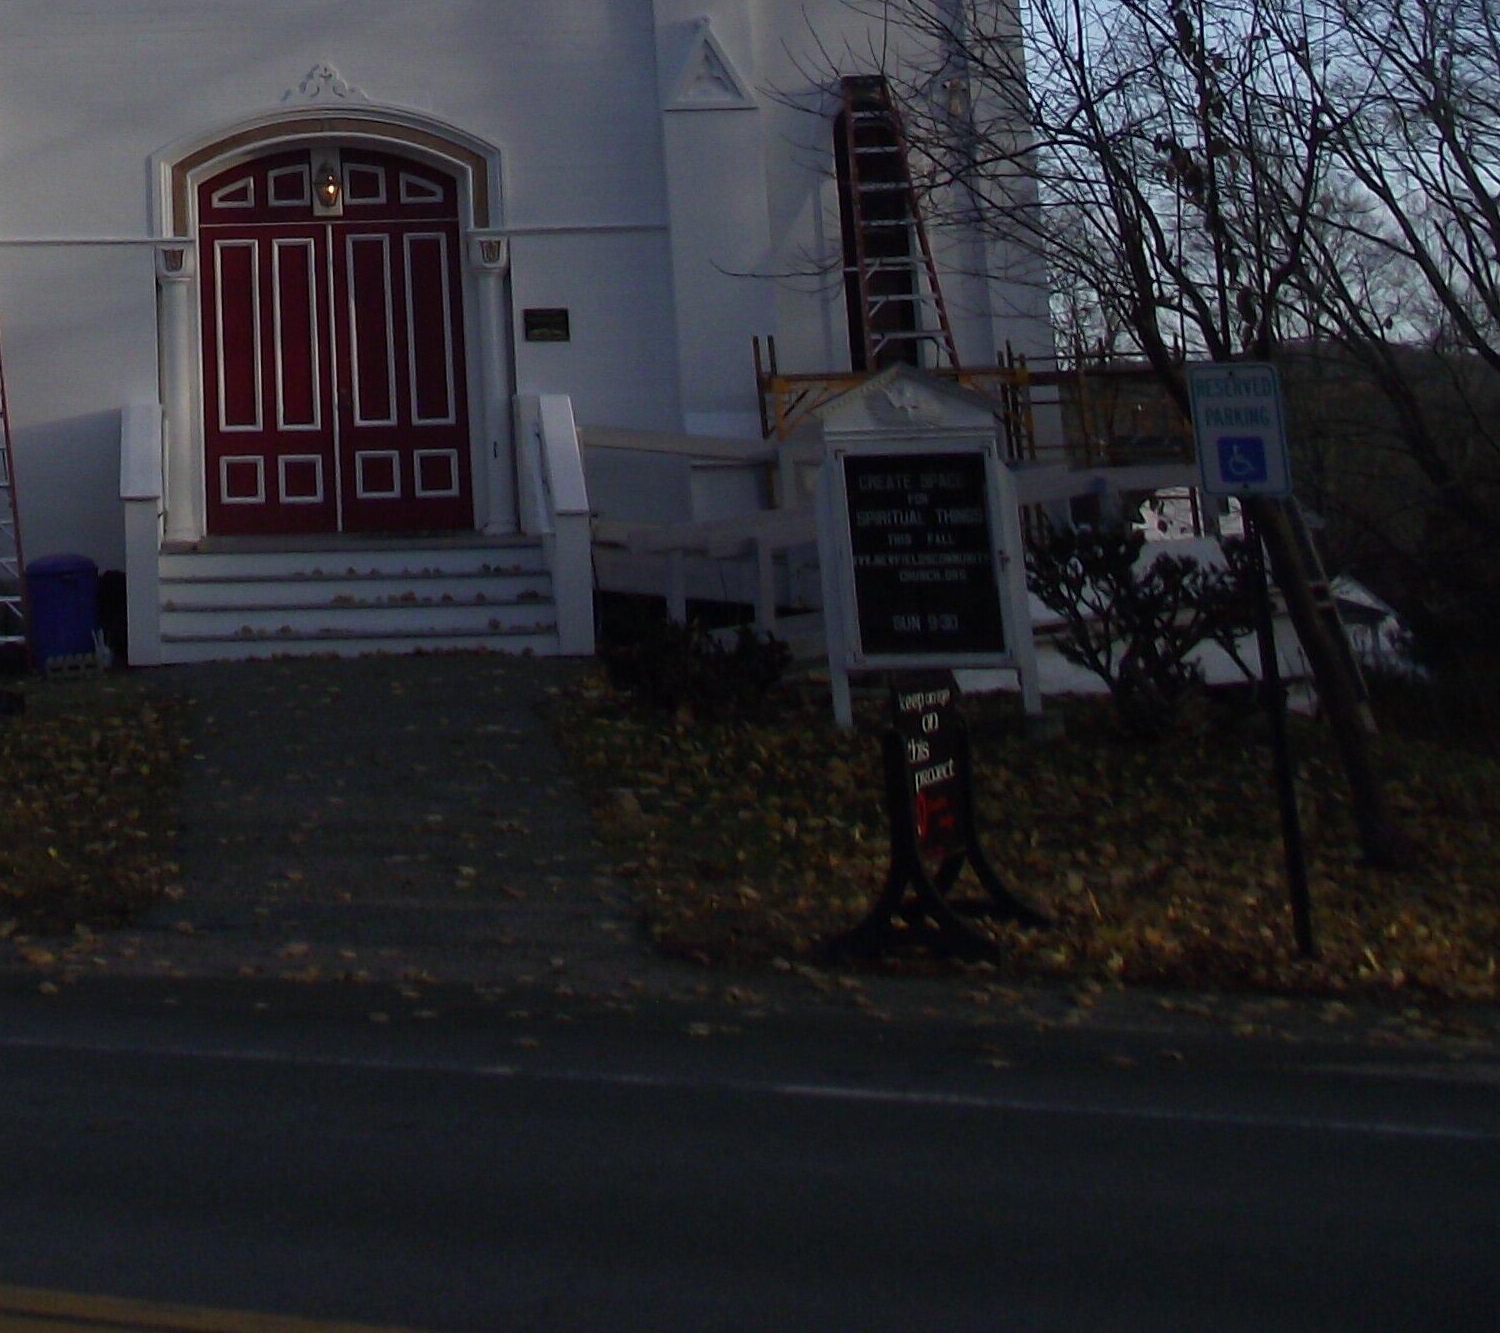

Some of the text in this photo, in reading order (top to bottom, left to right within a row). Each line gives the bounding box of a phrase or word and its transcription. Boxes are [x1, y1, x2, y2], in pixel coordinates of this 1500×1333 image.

[1196, 376, 1272, 398] RESERVED
[1204, 405, 1271, 427] PARKING
[858, 473, 912, 490] CREATE
[857, 508, 984, 527] SPIRITUAL THINGS
[888, 532, 957, 545] THIS FALL
[891, 614, 921, 632] SUN
[897, 690, 924, 713] keep
[922, 711, 940, 733] on
[907, 737, 930, 764] this
